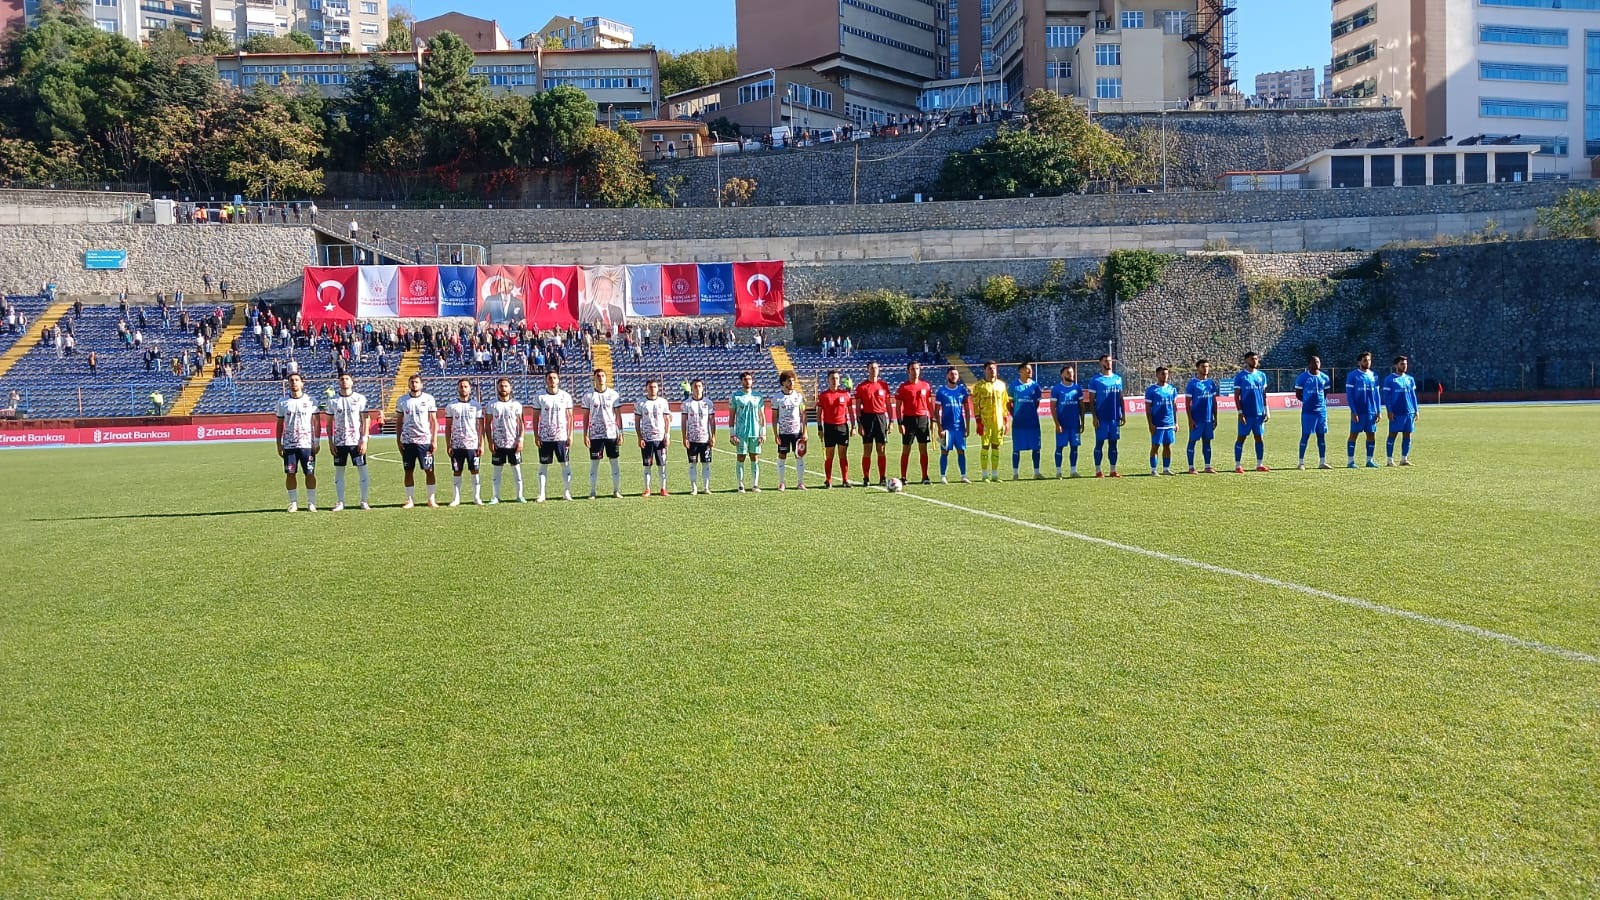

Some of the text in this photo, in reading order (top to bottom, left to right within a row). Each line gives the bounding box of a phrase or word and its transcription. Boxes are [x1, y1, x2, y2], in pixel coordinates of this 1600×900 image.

[103, 430, 170, 440] Ziraat Bankası
[206, 427, 271, 437] Ziraat Bankası
[28, 433, 65, 442] Bankası
